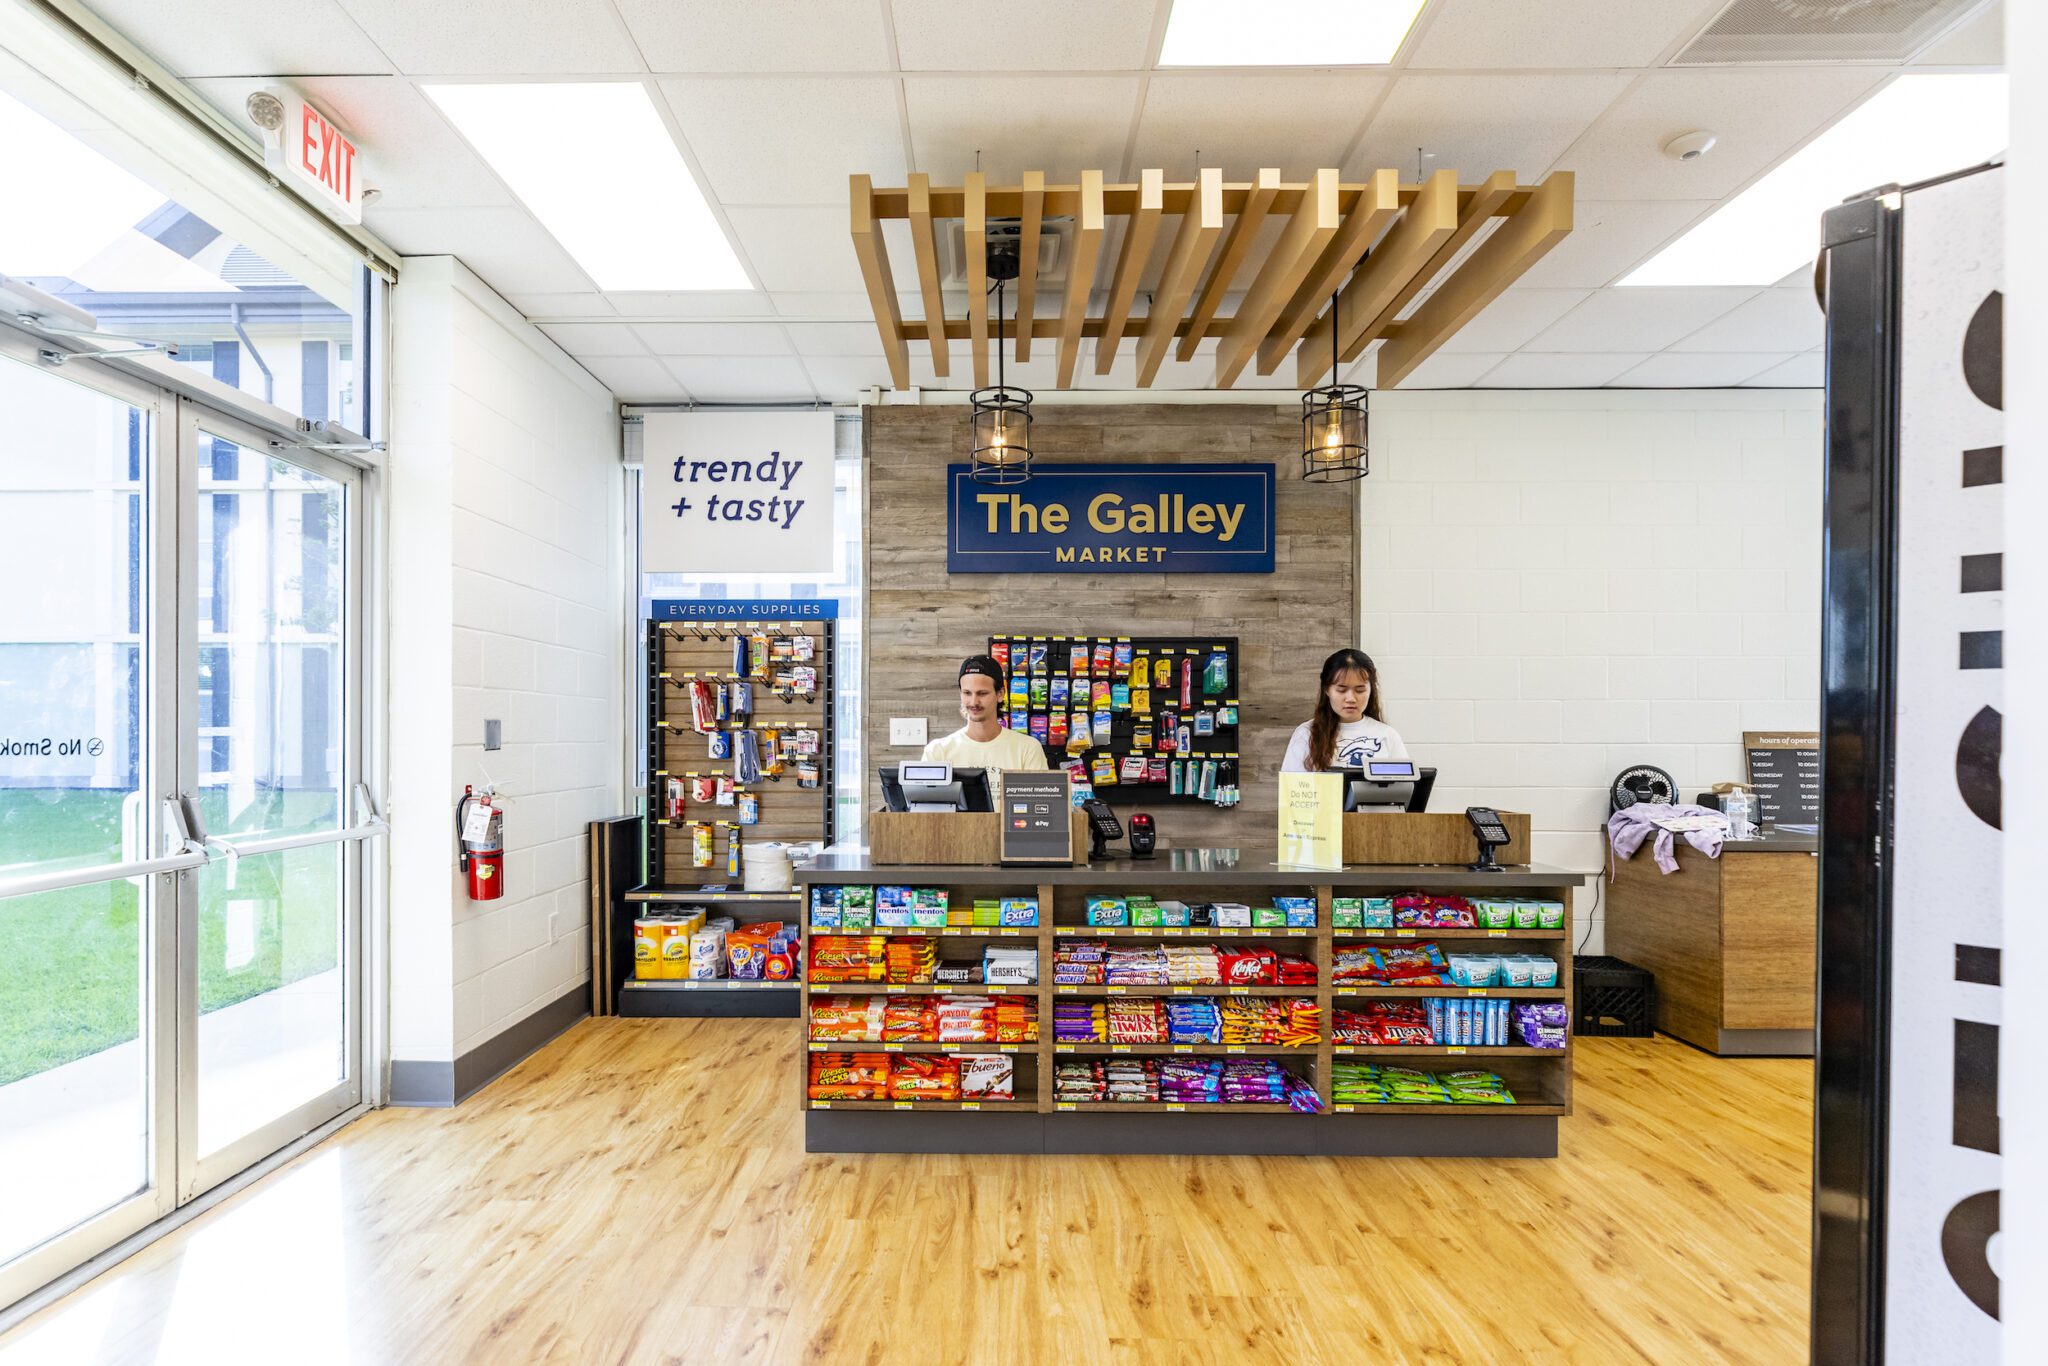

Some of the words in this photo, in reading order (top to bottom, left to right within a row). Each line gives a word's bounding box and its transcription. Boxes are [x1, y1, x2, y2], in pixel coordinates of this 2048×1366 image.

[303, 103, 356, 204] EXIT
[673, 451, 803, 491] trendy
[671, 497, 692, 518] +
[707, 494, 805, 530] tasty
[976, 493, 1070, 534] The
[1087, 493, 1246, 542] Galley
[1055, 546, 1168, 563] MARKET
[669, 605, 745, 615] EVERYDAY
[752, 605, 821, 615] SUPPLIES
[1759, 736, 1781, 745] hours
[1781, 736, 1791, 746] of
[1006, 786, 1034, 794] payment
[1301, 791, 1318, 800] NOT
[1290, 801, 1321, 809] ACCEPT
[878, 907, 910, 915] mentos
[1005, 909, 1035, 923] Extra
[1094, 908, 1122, 922] Extra
[732, 948, 749, 960] Tide
[937, 969, 969, 979] HERSHEY'S
[990, 967, 1022, 978] HERSHEY'S
[1057, 964, 1087, 974] SNICKERS
[1055, 975, 1085, 983] SNICKERS
[942, 1009, 970, 1018] PAYDAY
[1115, 1020, 1155, 1033] TWIX
[972, 1061, 1005, 1074] bueno
[819, 1073, 849, 1086] STICKS
